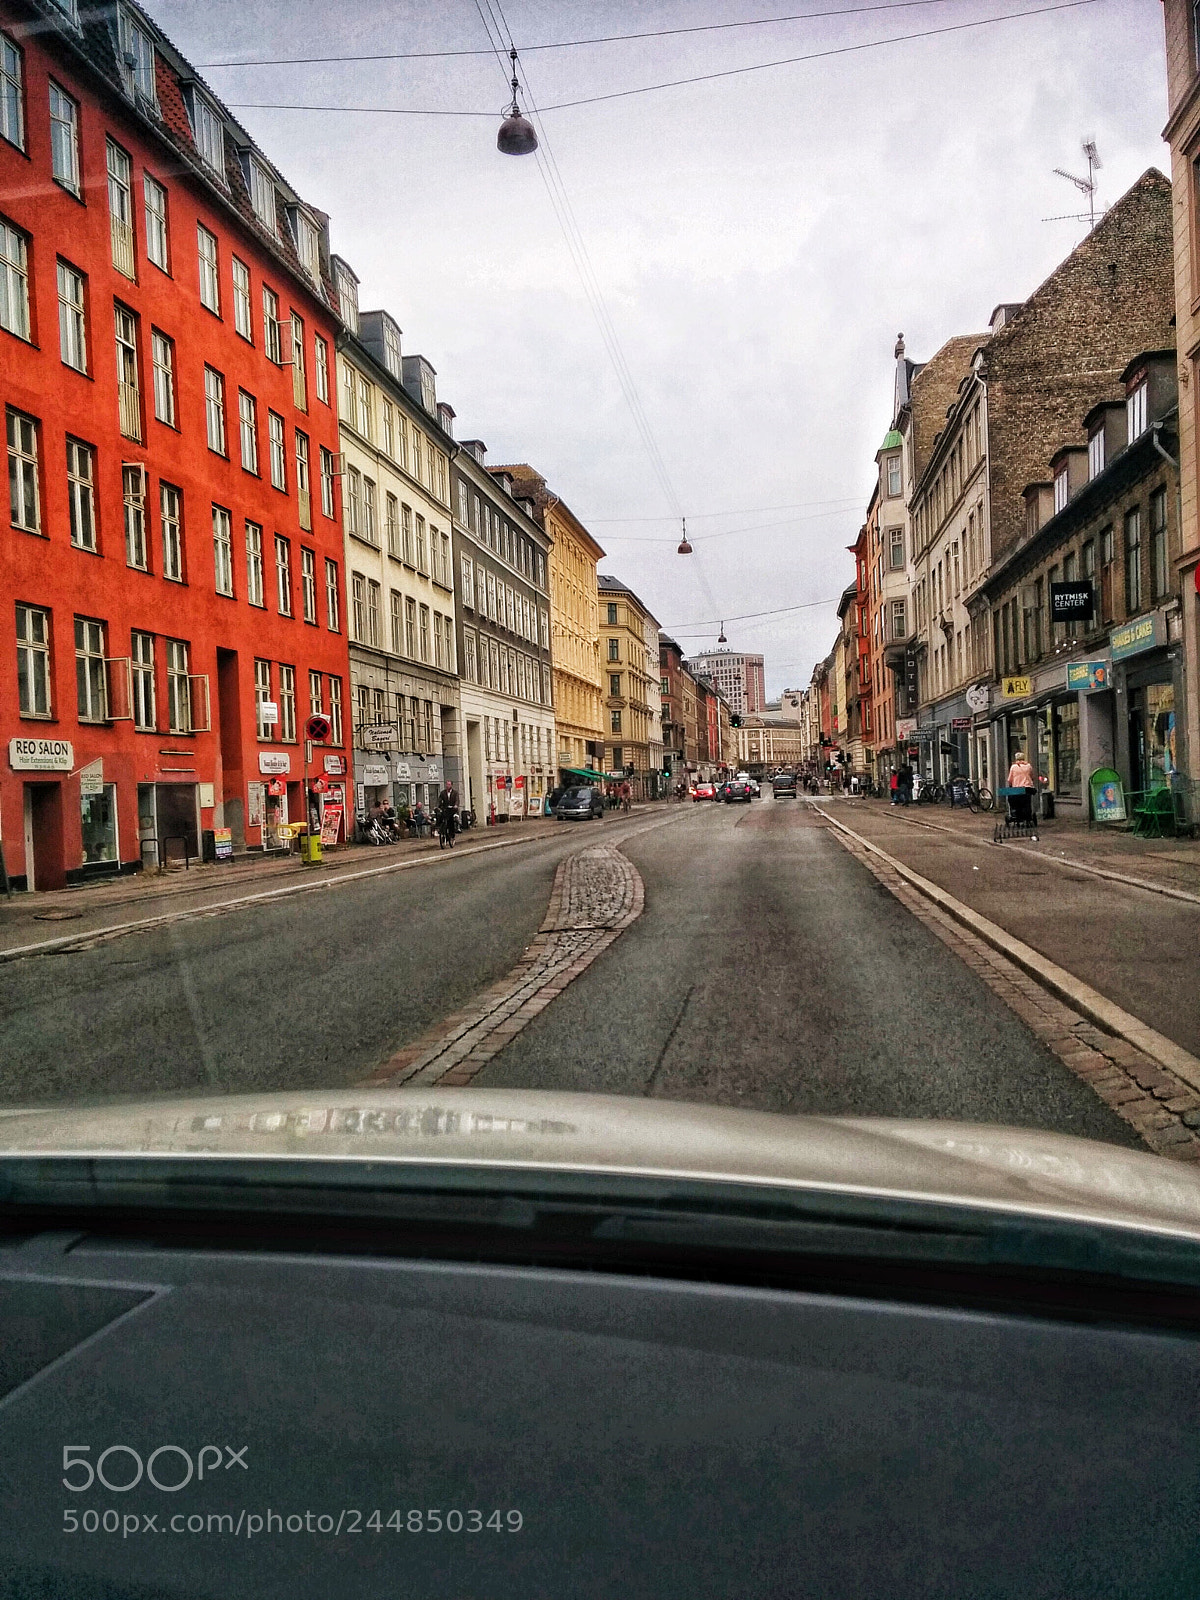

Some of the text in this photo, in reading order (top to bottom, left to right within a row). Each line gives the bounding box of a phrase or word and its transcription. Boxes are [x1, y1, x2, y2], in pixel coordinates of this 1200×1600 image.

[1054, 592, 1089, 601] RYTMISK
[1054, 600, 1085, 608] CENTER
[1135, 620, 1152, 639] CAKES
[907, 649, 916, 703] HOTEL
[1015, 681, 1028, 692] FLY
[38, 741, 69, 756] SALON
[19, 756, 30, 764] Hair
